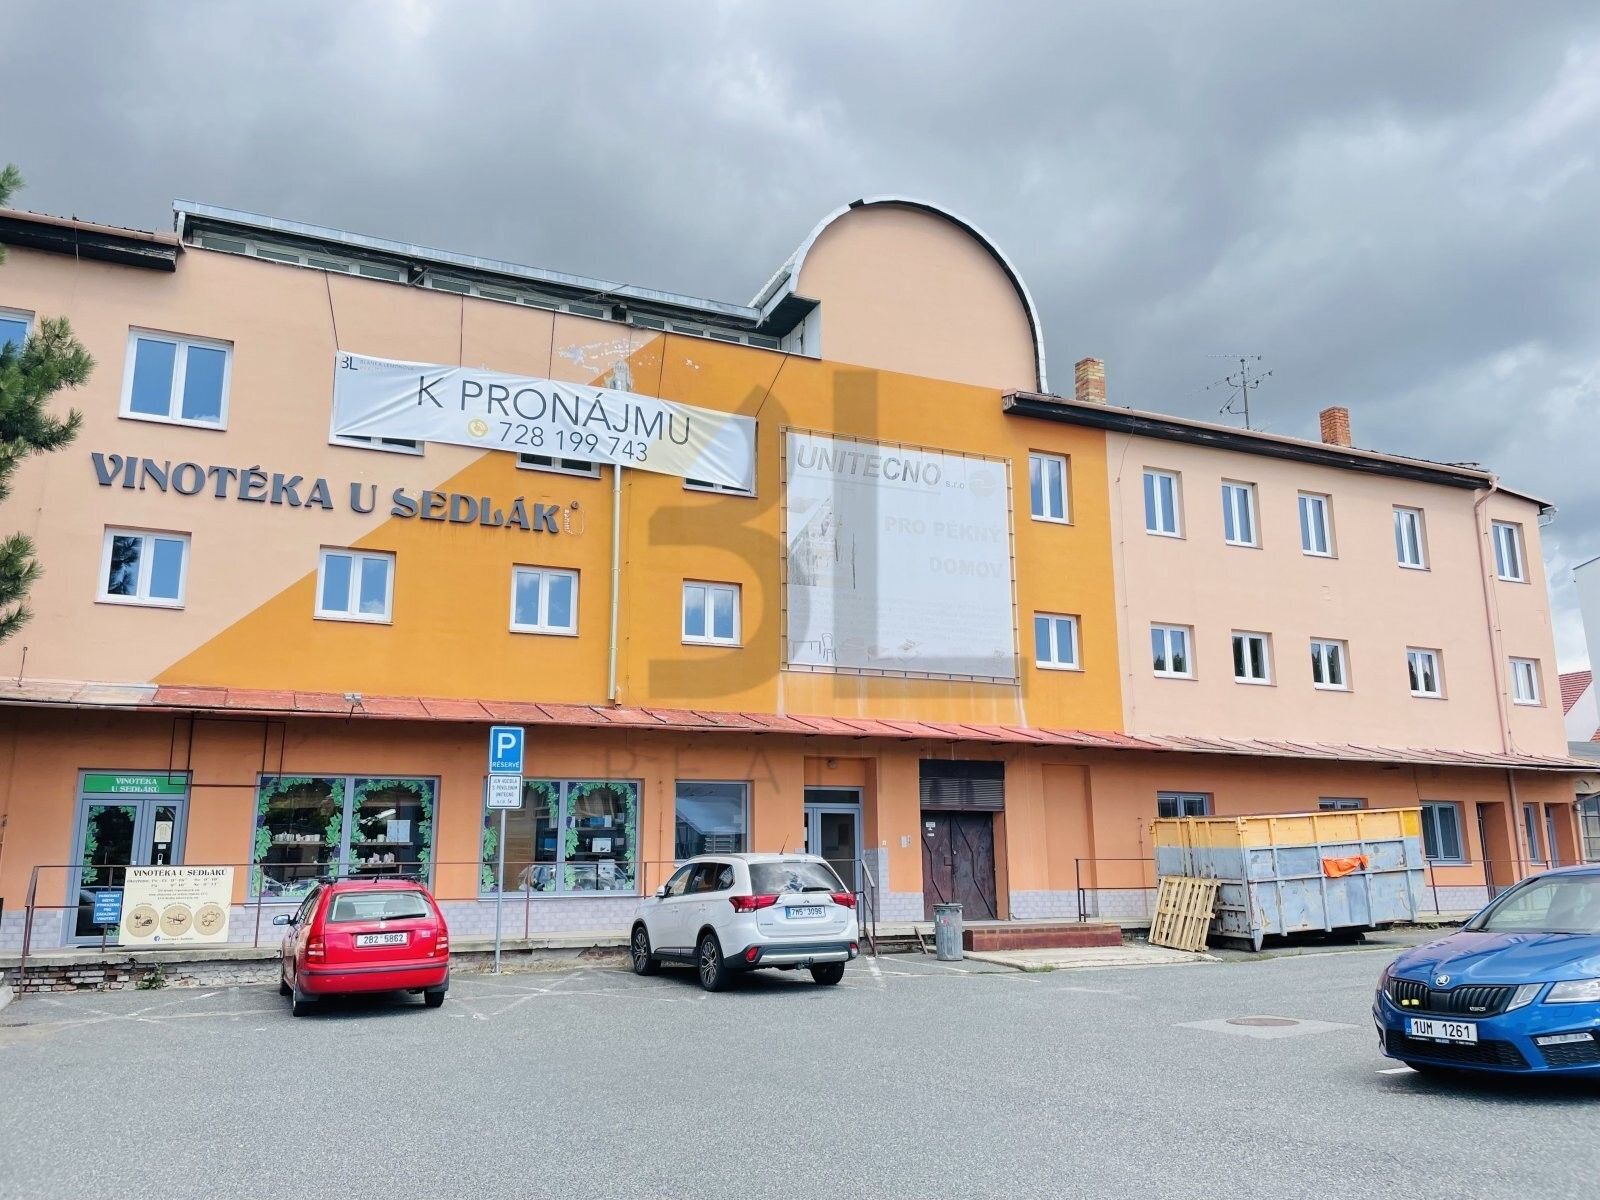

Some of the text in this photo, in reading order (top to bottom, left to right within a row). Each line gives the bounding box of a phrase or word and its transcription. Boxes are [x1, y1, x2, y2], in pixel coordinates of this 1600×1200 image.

[418, 375, 690, 445] K PRONÁJMU
[499, 421, 648, 462] 728 199 743
[797, 444, 942, 486] UNITECNO
[91, 452, 334, 510] VINOTÉKA
[350, 482, 378, 514] U
[884, 515, 927, 535] PRO
[928, 556, 1004, 579] DOMOV
[497, 733, 517, 759] P
[1413, 1020, 1471, 1039] 1UM 1261
